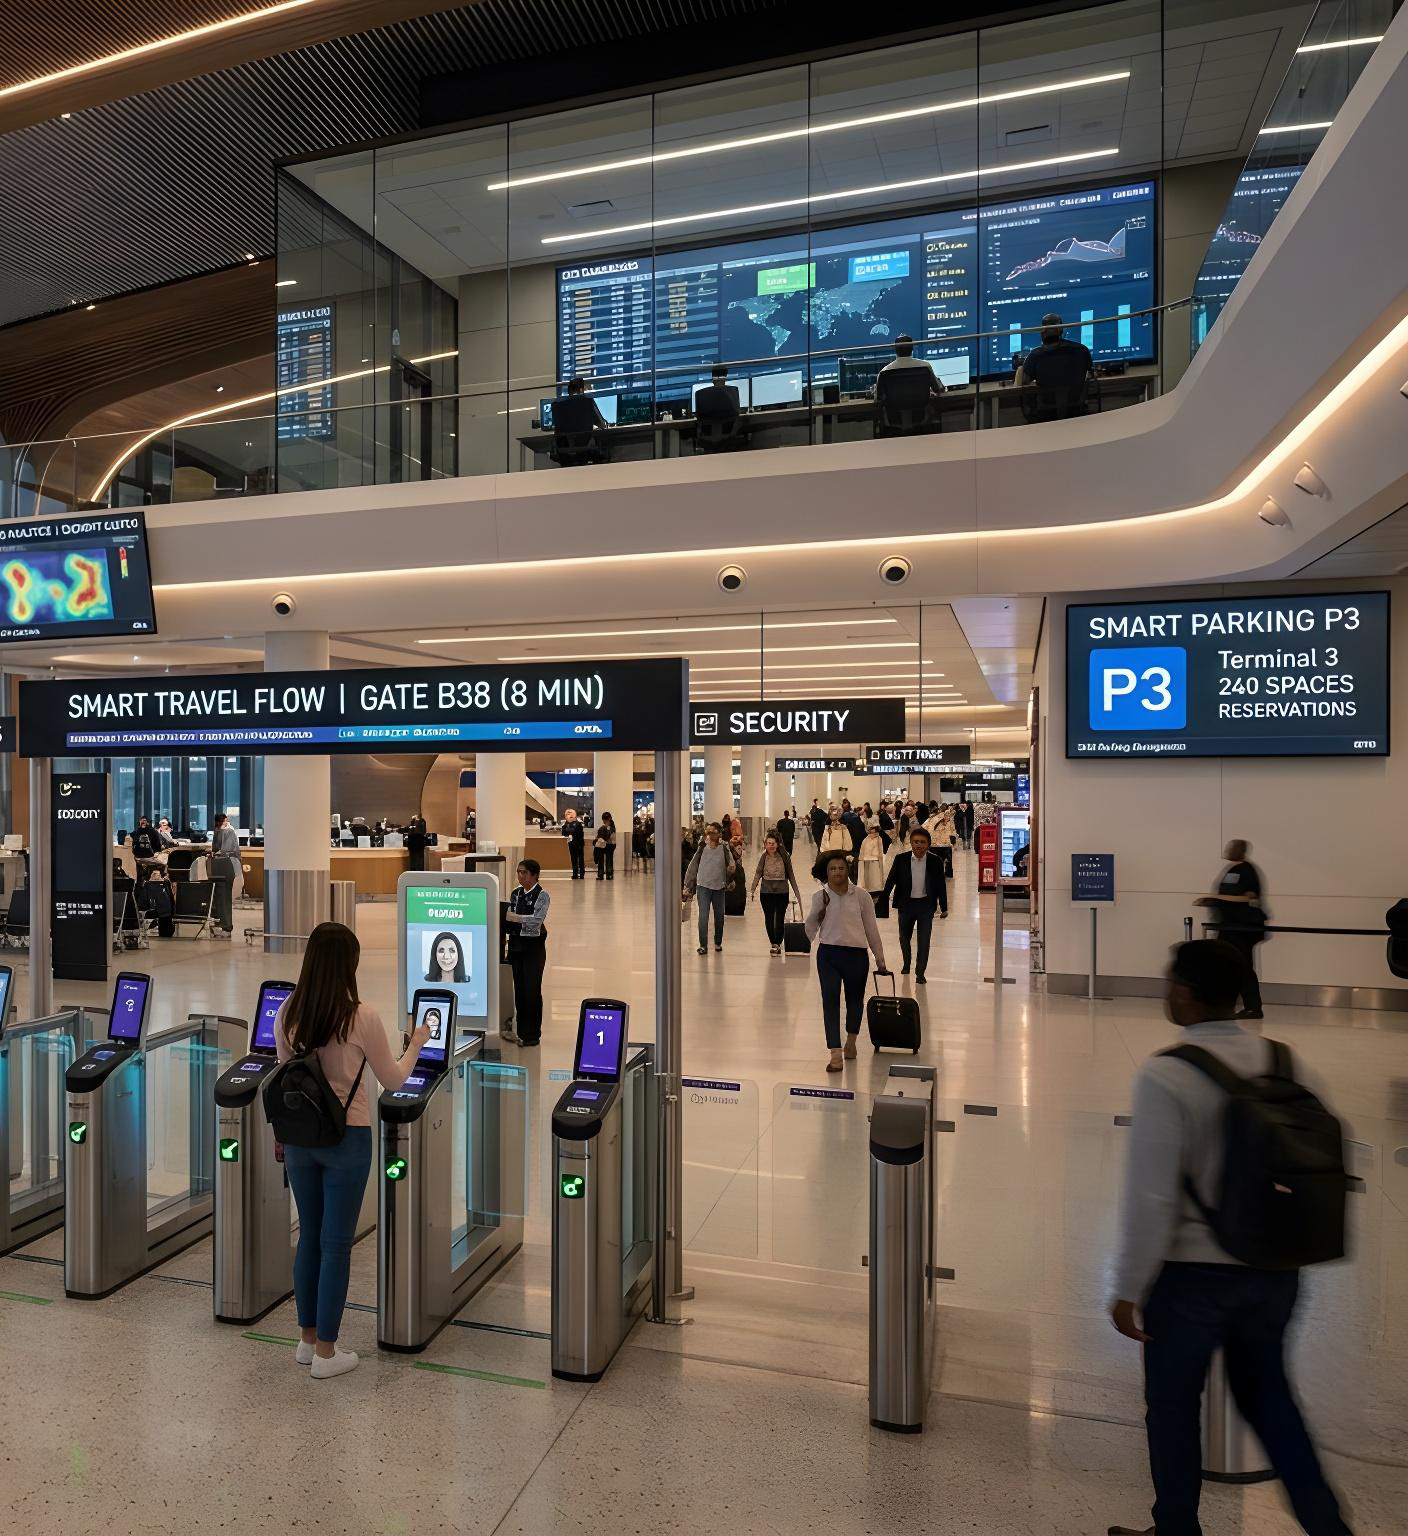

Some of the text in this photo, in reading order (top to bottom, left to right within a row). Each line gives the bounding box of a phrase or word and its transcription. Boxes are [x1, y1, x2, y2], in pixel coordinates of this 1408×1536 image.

[1090, 607, 1360, 639] SMART PARKING P3
[1218, 648, 1338, 669] Terminal 3
[1103, 667, 1172, 711] P3
[1219, 675, 1354, 695] 240 SPACES
[68, 692, 148, 718] SMART
[154, 690, 247, 715] TRAVEL
[255, 686, 325, 713] FLOW
[361, 683, 428, 710] GATE
[438, 680, 491, 708] B38
[500, 678, 528, 711] (8
[539, 675, 604, 709] MIN)
[730, 710, 849, 733] SECURITY
[1219, 702, 1357, 719] RESERVATIONS
[596, 1030, 605, 1046] 1
